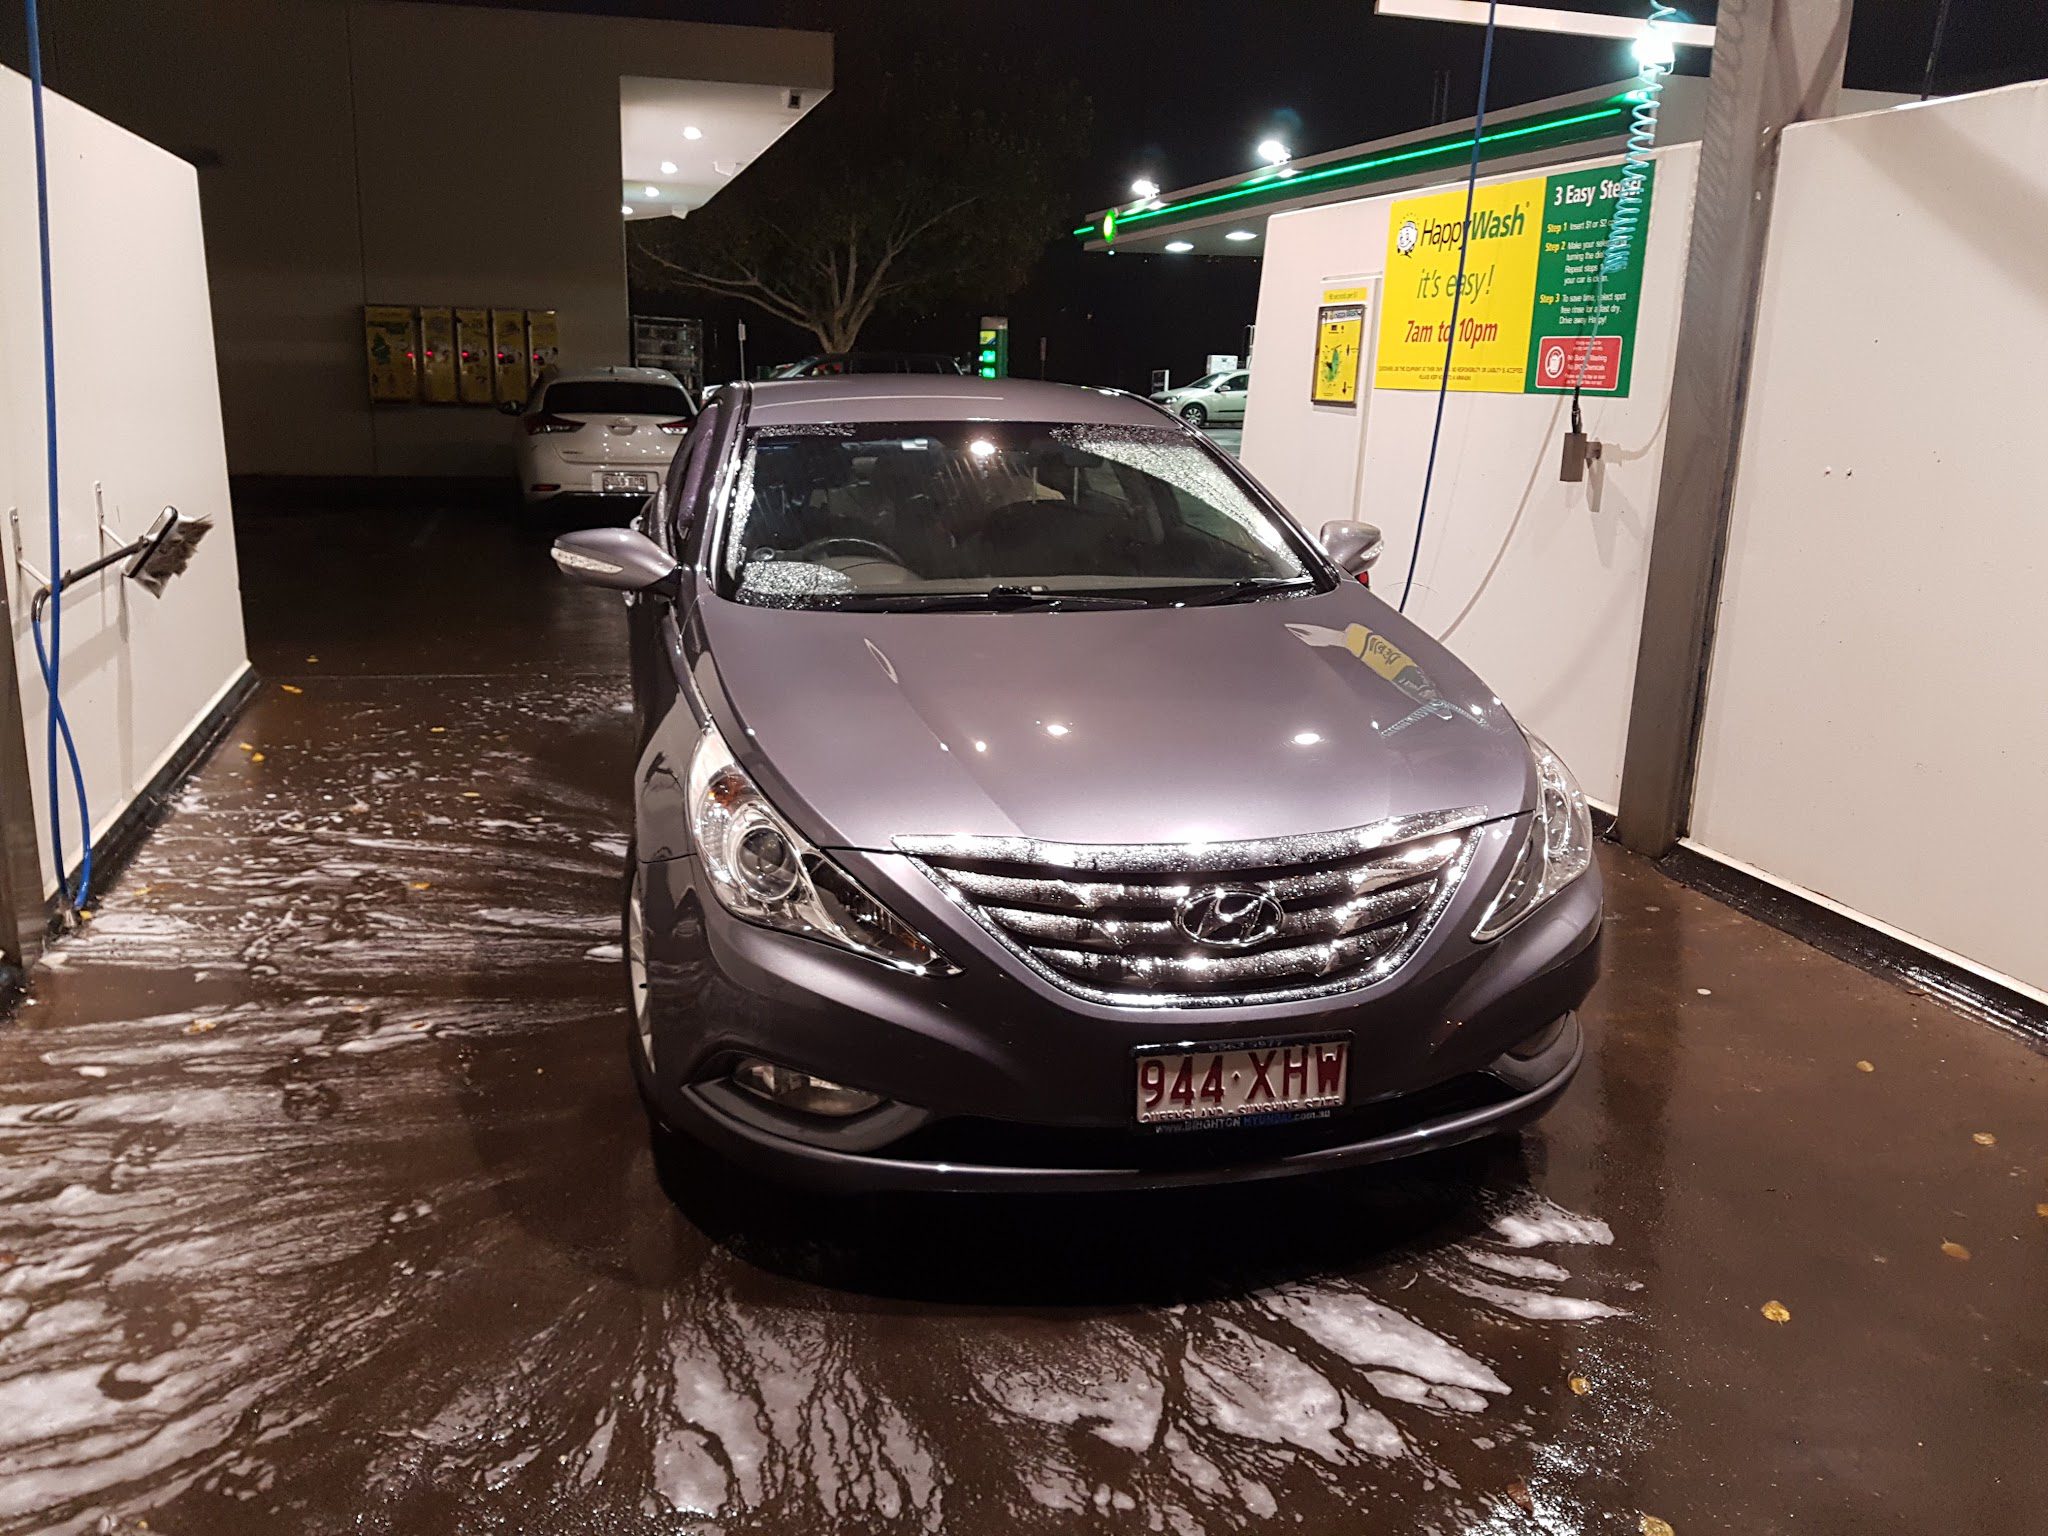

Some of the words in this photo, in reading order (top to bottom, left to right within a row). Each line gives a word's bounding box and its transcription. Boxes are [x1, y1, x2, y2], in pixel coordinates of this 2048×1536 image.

[1554, 186, 1563, 206] 3
[1565, 184, 1596, 207] Easy
[1547, 223, 1561, 234] Step
[1563, 222, 1568, 231] 1
[1545, 242, 1560, 253] Step
[1561, 241, 1566, 250] 2
[1416, 268, 1441, 299] it's
[1446, 264, 1495, 305] easy!
[1540, 294, 1554, 305] Step
[1555, 293, 1560, 303] 3
[1562, 294, 1569, 302] To
[1405, 320, 1433, 343] 7am
[1438, 320, 1451, 343] to
[1458, 317, 1498, 349] 10pm
[1304, 1095, 1343, 1109] STATE
